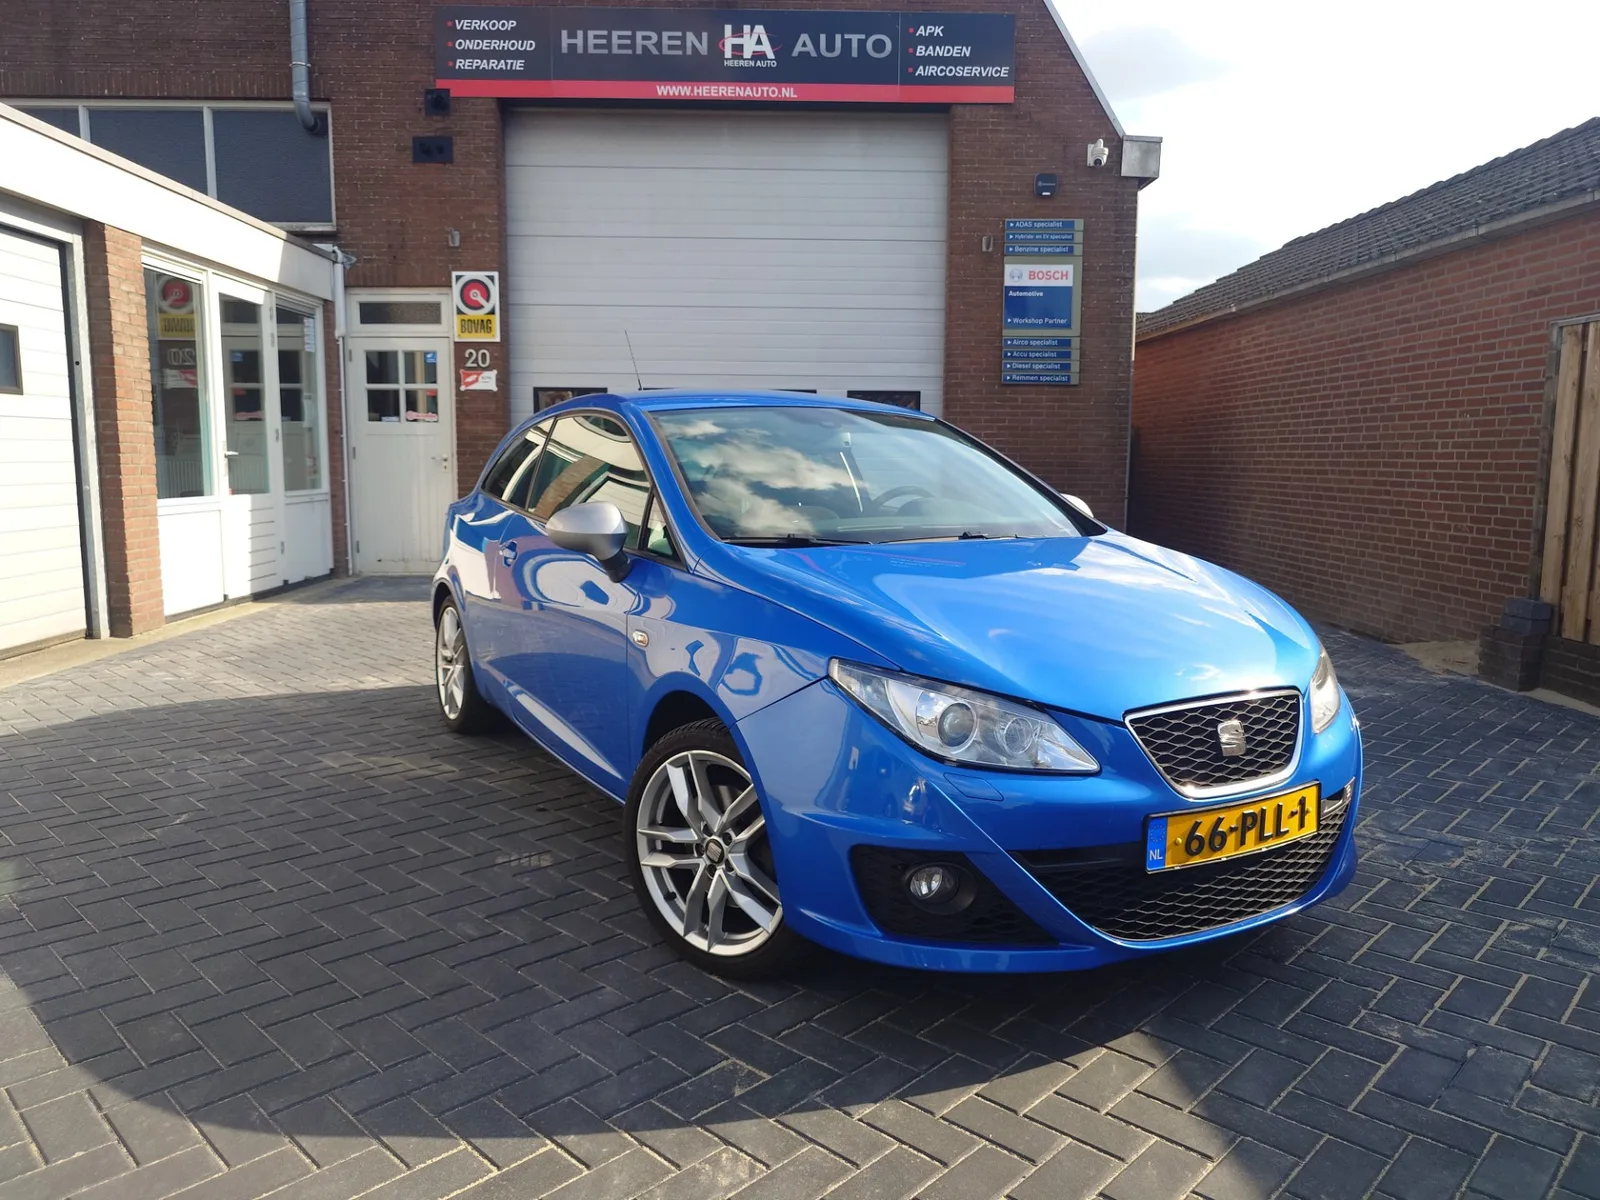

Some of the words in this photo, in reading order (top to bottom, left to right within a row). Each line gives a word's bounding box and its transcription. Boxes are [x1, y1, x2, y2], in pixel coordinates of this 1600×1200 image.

[455, 19, 517, 31] VERKOOP
[916, 25, 944, 37] APK
[455, 39, 536, 51] ONDERHOUD
[560, 29, 708, 55] HEEREN
[724, 24, 776, 60] HA
[791, 33, 893, 58] AUTO
[915, 45, 971, 57] BANDEN
[455, 59, 525, 71] REPARATIE
[915, 65, 1009, 78] AIRCOSERVICE
[656, 85, 798, 98] WWW.HEERENAUTO.NL
[1033, 221, 1063, 229] specialist
[1040, 246, 1069, 254] specialist
[1028, 270, 1069, 280] BOSCH
[460, 319, 493, 334] BOVAG
[1012, 317, 1044, 325] Workshop
[464, 349, 491, 368] 20
[1185, 796, 1307, 856] 66-PLL-1
[1149, 849, 1163, 860] NL
